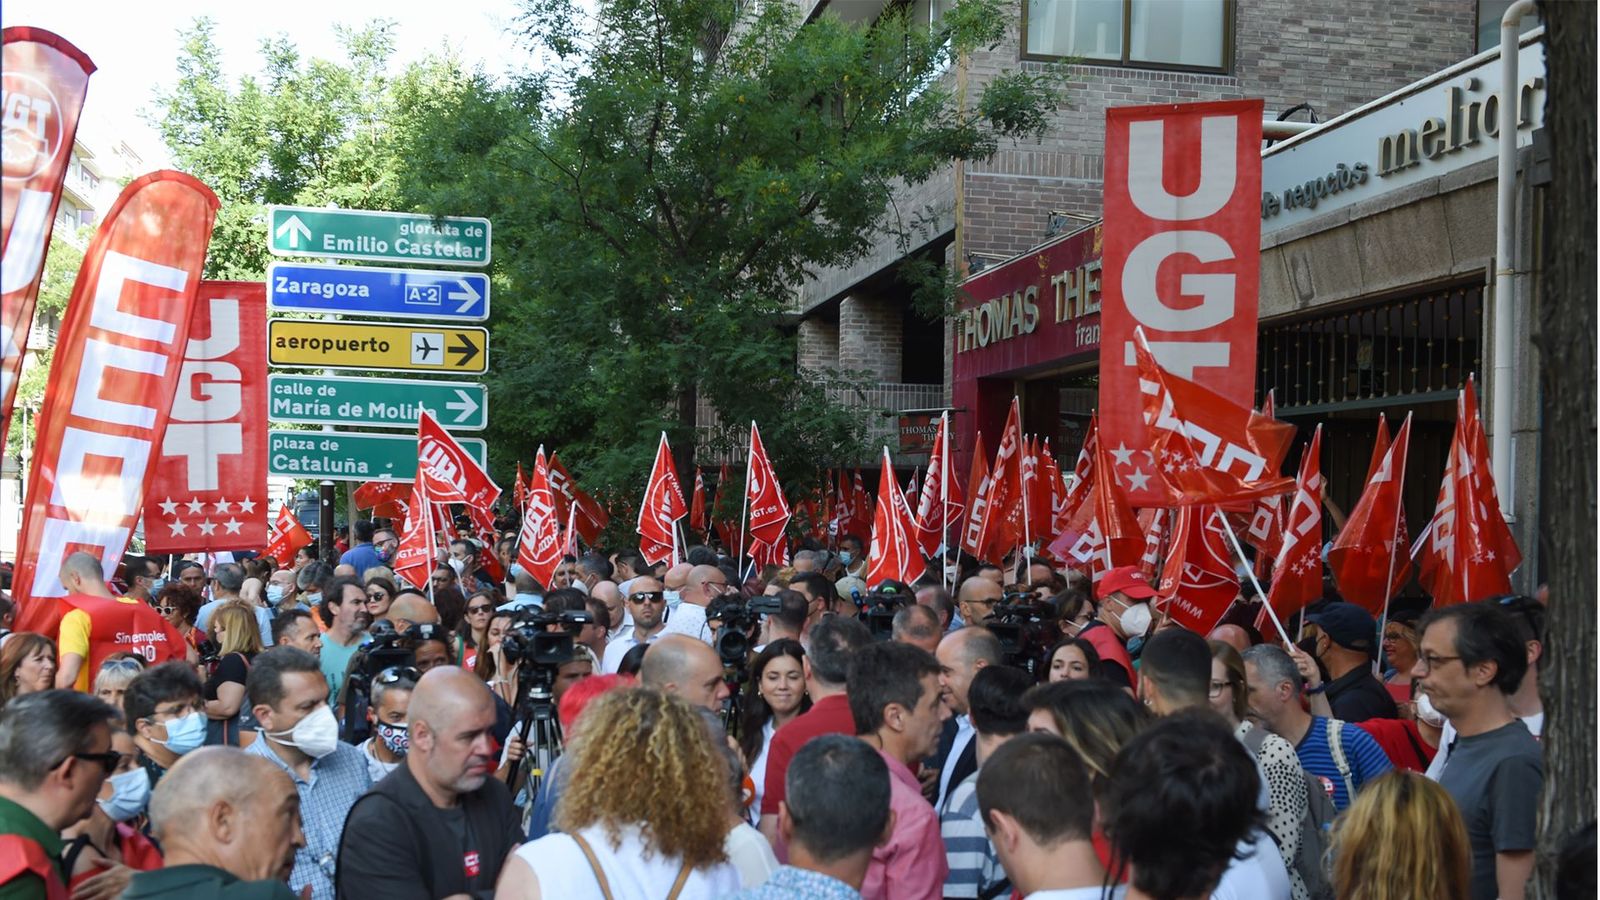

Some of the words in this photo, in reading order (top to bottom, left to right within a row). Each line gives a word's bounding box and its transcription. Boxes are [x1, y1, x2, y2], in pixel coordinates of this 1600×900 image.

[2, 90, 51, 140] GT
[1375, 77, 1544, 176] melior
[1284, 162, 1368, 211] negocios
[464, 225, 483, 237] de
[323, 234, 388, 253] Emilio
[395, 237, 483, 258] Castelar
[275, 276, 370, 298] Zaragoza
[409, 287, 438, 302] A-2
[955, 286, 1040, 354] THOMAS
[275, 336, 390, 353] aeropuerto
[274, 383, 313, 395] calle
[317, 384, 336, 396] de
[273, 399, 331, 416] María
[338, 401, 363, 417] de
[901, 425, 937, 434] THOMAS
[273, 437, 315, 450] plaza
[320, 439, 339, 451] de
[272, 454, 369, 473] Cataluña
[520, 494, 554, 551] UGT
[114, 631, 131, 645] Sin
